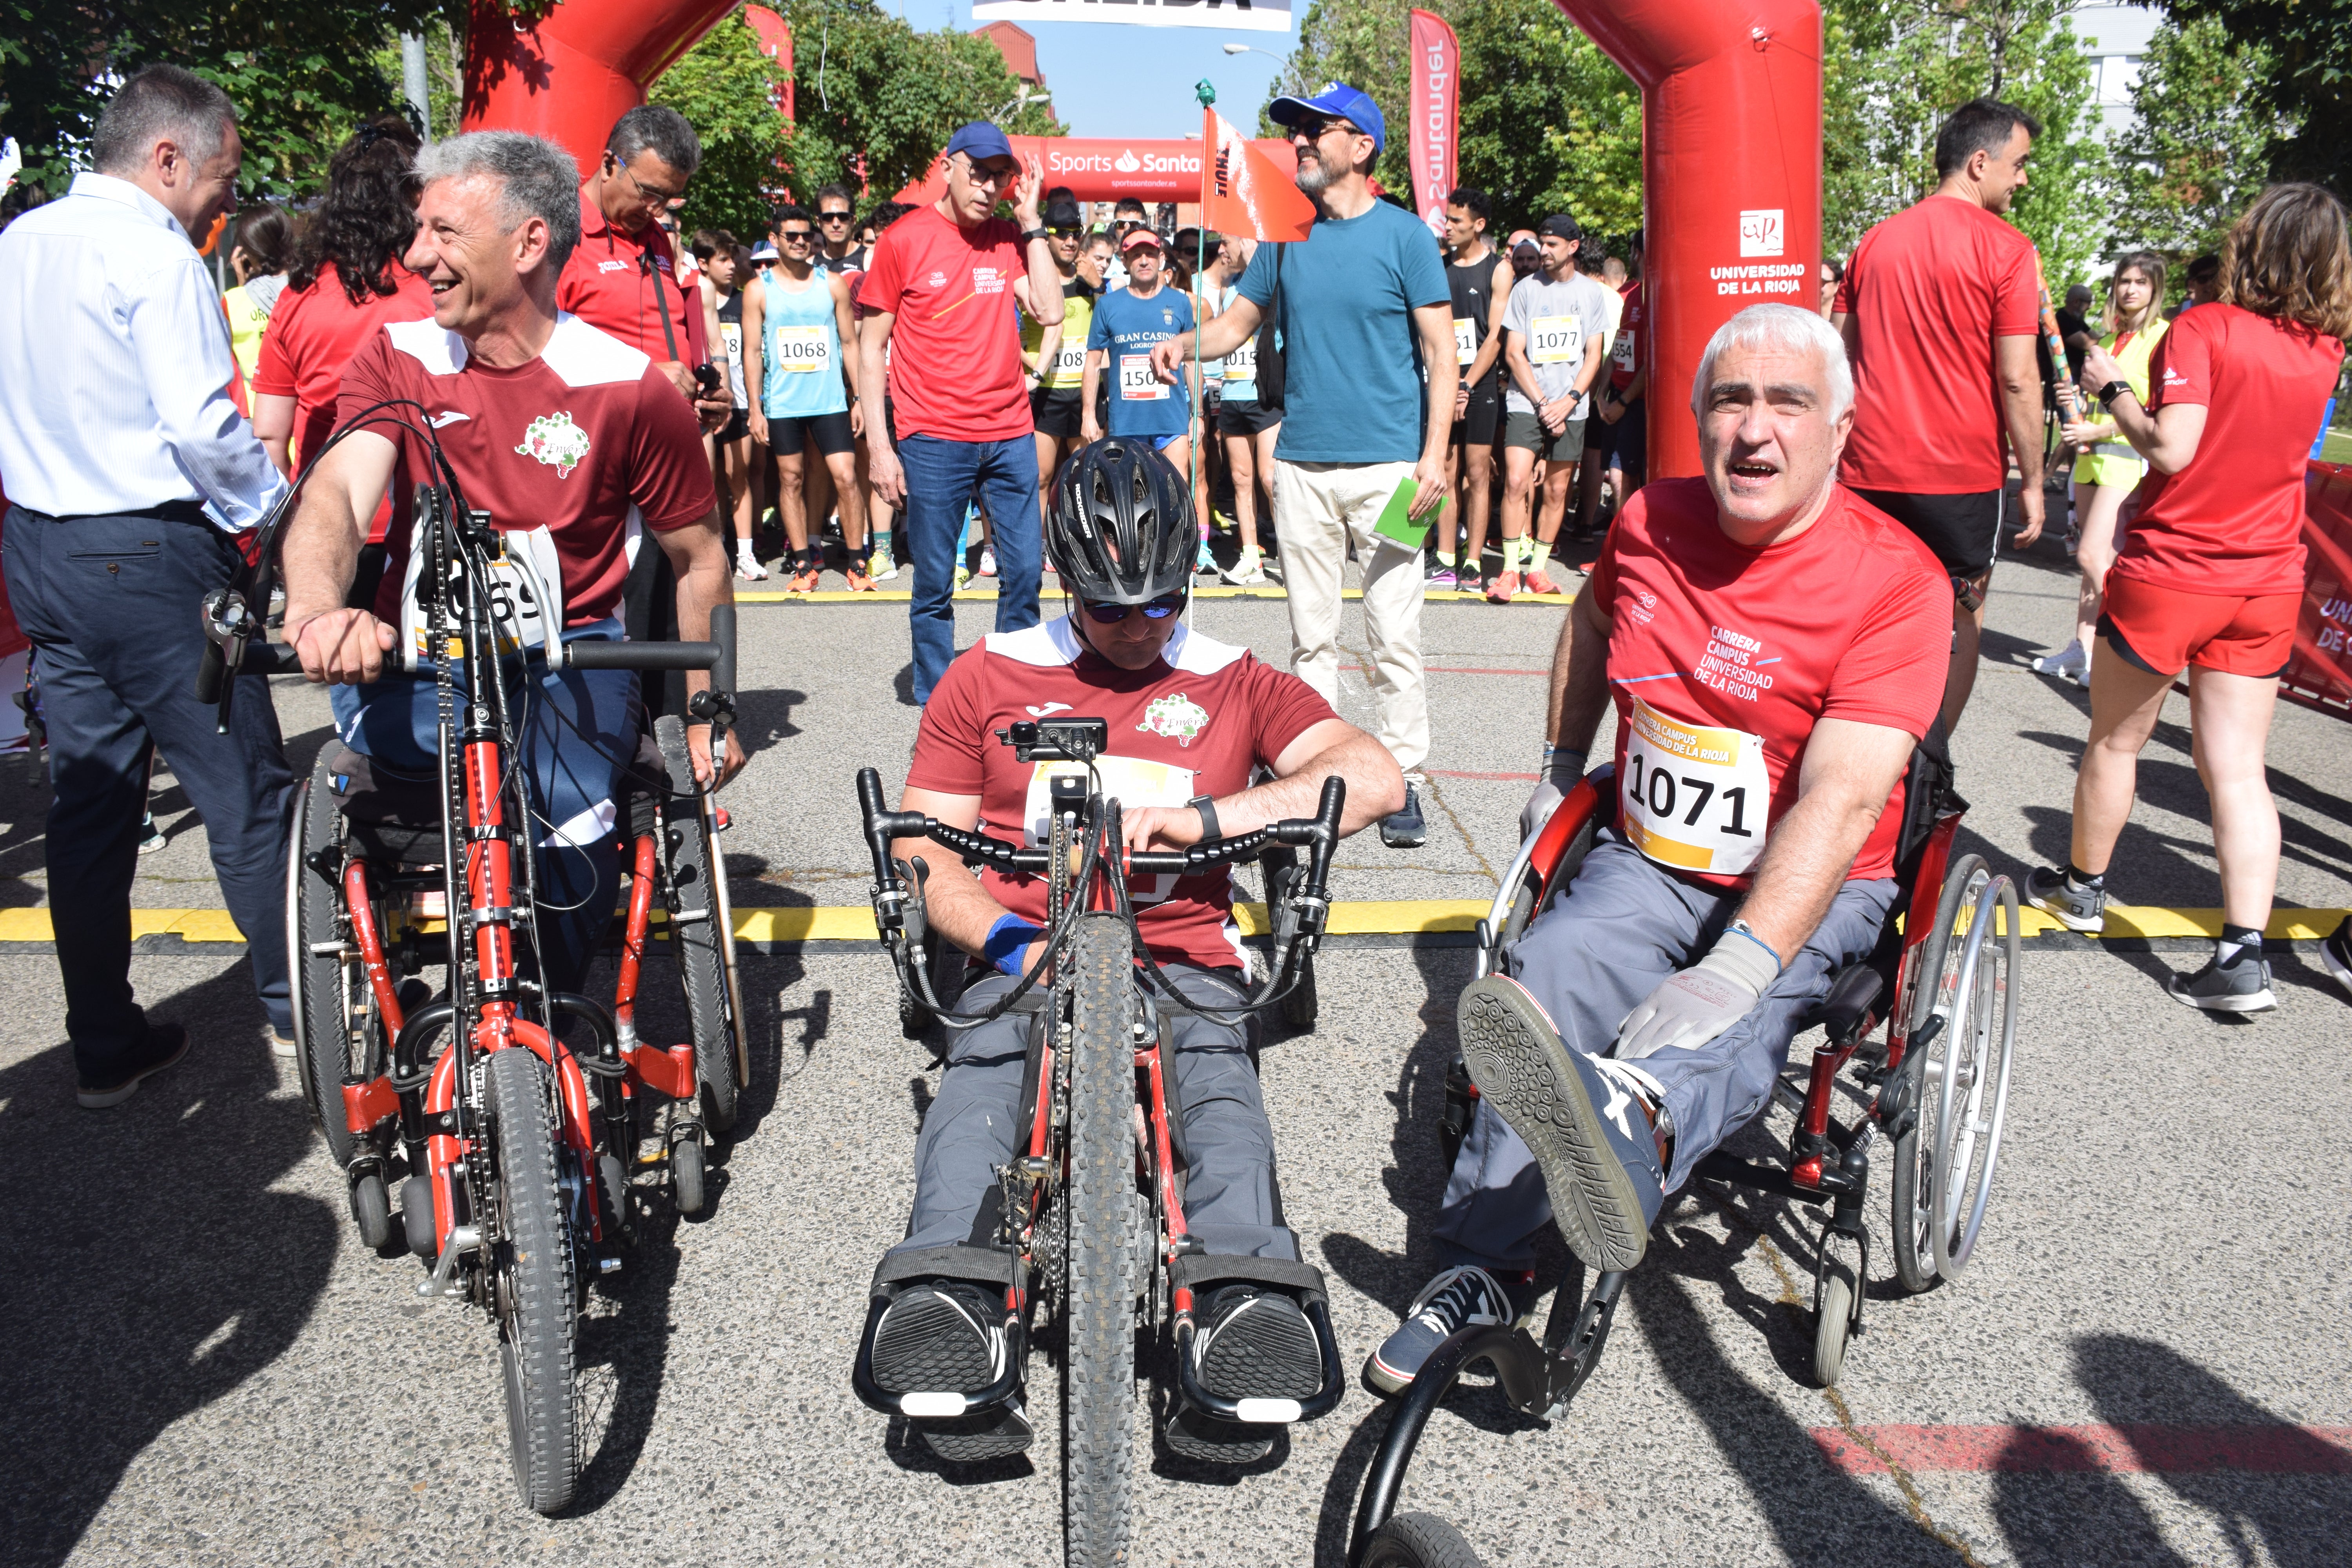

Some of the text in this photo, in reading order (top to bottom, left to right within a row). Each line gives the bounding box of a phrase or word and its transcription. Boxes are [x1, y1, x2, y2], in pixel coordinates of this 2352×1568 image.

[1049, 152, 1203, 175] Sports Santa
[1215, 148, 1229, 198] THULE
[1111, 180, 1176, 188] sportssantander.es
[1710, 264, 1805, 280] UNIVERSIDAD
[975, 279, 1005, 288] UNIVERSIDA
[1718, 279, 1800, 295] DE LA RIOJA
[250, 309, 269, 321] OR
[1115, 332, 1140, 344] GRAN
[1537, 332, 1577, 348] 1077
[782, 342, 826, 358] 1068
[1053, 352, 1087, 367] 108
[1125, 371, 1162, 386] 150
[547, 443, 587, 455] Envero
[1075, 483, 1092, 539] ROCKRIDER
[1632, 604, 1655, 619] UNIVERSIDAD
[1640, 614, 1651, 623] RIOJA
[1711, 625, 1761, 653] CARRERA
[2317, 627, 2344, 652] DE
[1707, 640, 1750, 666] CAMPUS
[1700, 654, 1773, 690] UNIVERSIDAD
[1694, 667, 1757, 702] DE LA RIOJA
[1167, 718, 1206, 726] Envero
[1637, 708, 1698, 746] CARRERA CAMPUS
[1635, 720, 1730, 762] UNIVERSIDAD DE LA RIOJA
[1630, 753, 1752, 838] 1071
